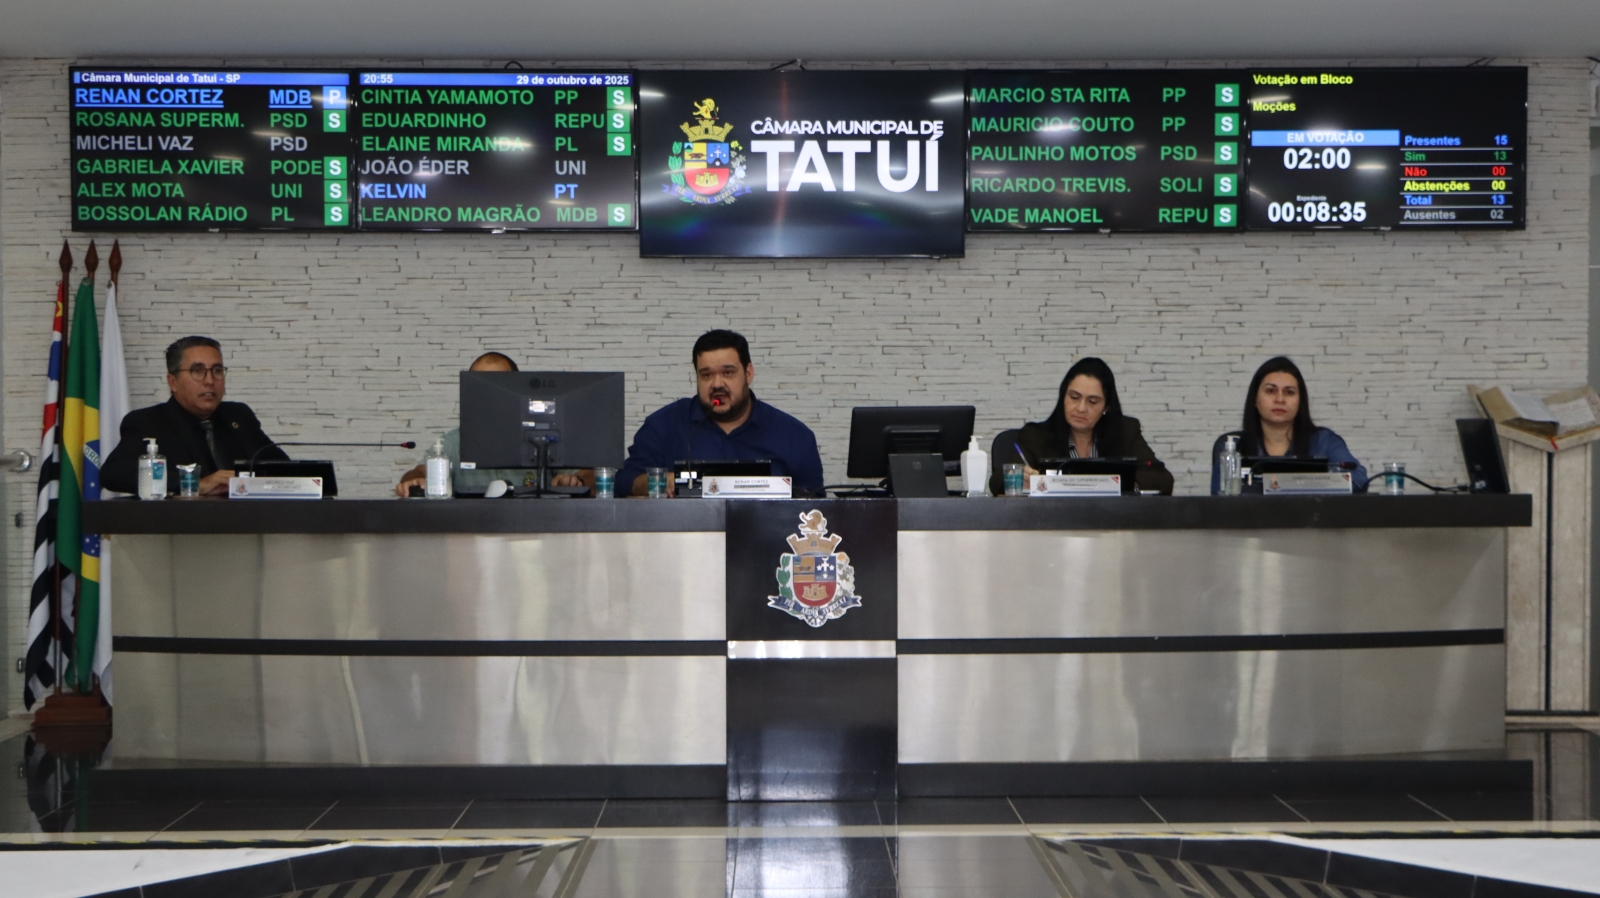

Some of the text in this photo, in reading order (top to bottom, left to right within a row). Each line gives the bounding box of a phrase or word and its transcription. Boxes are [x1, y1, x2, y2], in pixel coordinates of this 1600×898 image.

[82, 73, 121, 83] Câmara
[124, 73, 174, 84] Municipal
[177, 74, 189, 83] de
[192, 74, 217, 83] Tatuí
[226, 74, 240, 83] SP
[364, 75, 393, 83] 20:55
[517, 76, 629, 84] 29 de outubro de 2025
[1253, 75, 1353, 86] Votação em Bloco
[75, 89, 341, 105] RENAN CORTEZ MDB P
[361, 89, 624, 105] CINTIA YAMAMOTO PP S
[971, 87, 1233, 103] MARCIO STA RITA PP S
[1253, 101, 1296, 113] Moções
[76, 112, 341, 128] ROSANA SUPERM. PSD S
[362, 113, 624, 128] EDUARDINHO REPU S
[751, 117, 943, 135] CÂMARA MUNICIPAL DE
[971, 116, 1233, 132] MAURICIO COUTO PP S
[76, 136, 307, 151] MICHELI VAZ PSD
[362, 137, 625, 152] ELAINE MIRANDA PL S
[1287, 131, 1364, 144] EM VOTAÇÃO
[1405, 136, 1508, 147] Presentes 15
[971, 146, 1232, 161] PAULINHO MOTOS PSD S
[1284, 148, 1350, 169] 02:00
[1405, 152, 1507, 161] Sim 13
[77, 159, 341, 175] GABRIELA XAVIER PODE S
[361, 157, 586, 175] JOÃO ÉDER UNI
[751, 134, 943, 192] TATUÍ
[1405, 166, 1506, 176] Não 00
[77, 183, 341, 198] ALEX MOTA UNI S
[361, 184, 578, 198] KELVIN PT
[971, 177, 1232, 192] RICARDO TREVIS. SOLI S
[1404, 181, 1506, 192] Abstenções 00
[1405, 195, 1505, 205] Total 13
[78, 202, 342, 222] BOSSOLAN RÁDIO PL S
[362, 204, 625, 222] LEANDRO MAGRÃO MDB S
[971, 208, 1231, 223] VADE MANOEL REPU S
[1268, 202, 1367, 222] 00:08:35
[1404, 210, 1504, 220] Ausentes 02
[543, 380, 556, 388] LG
